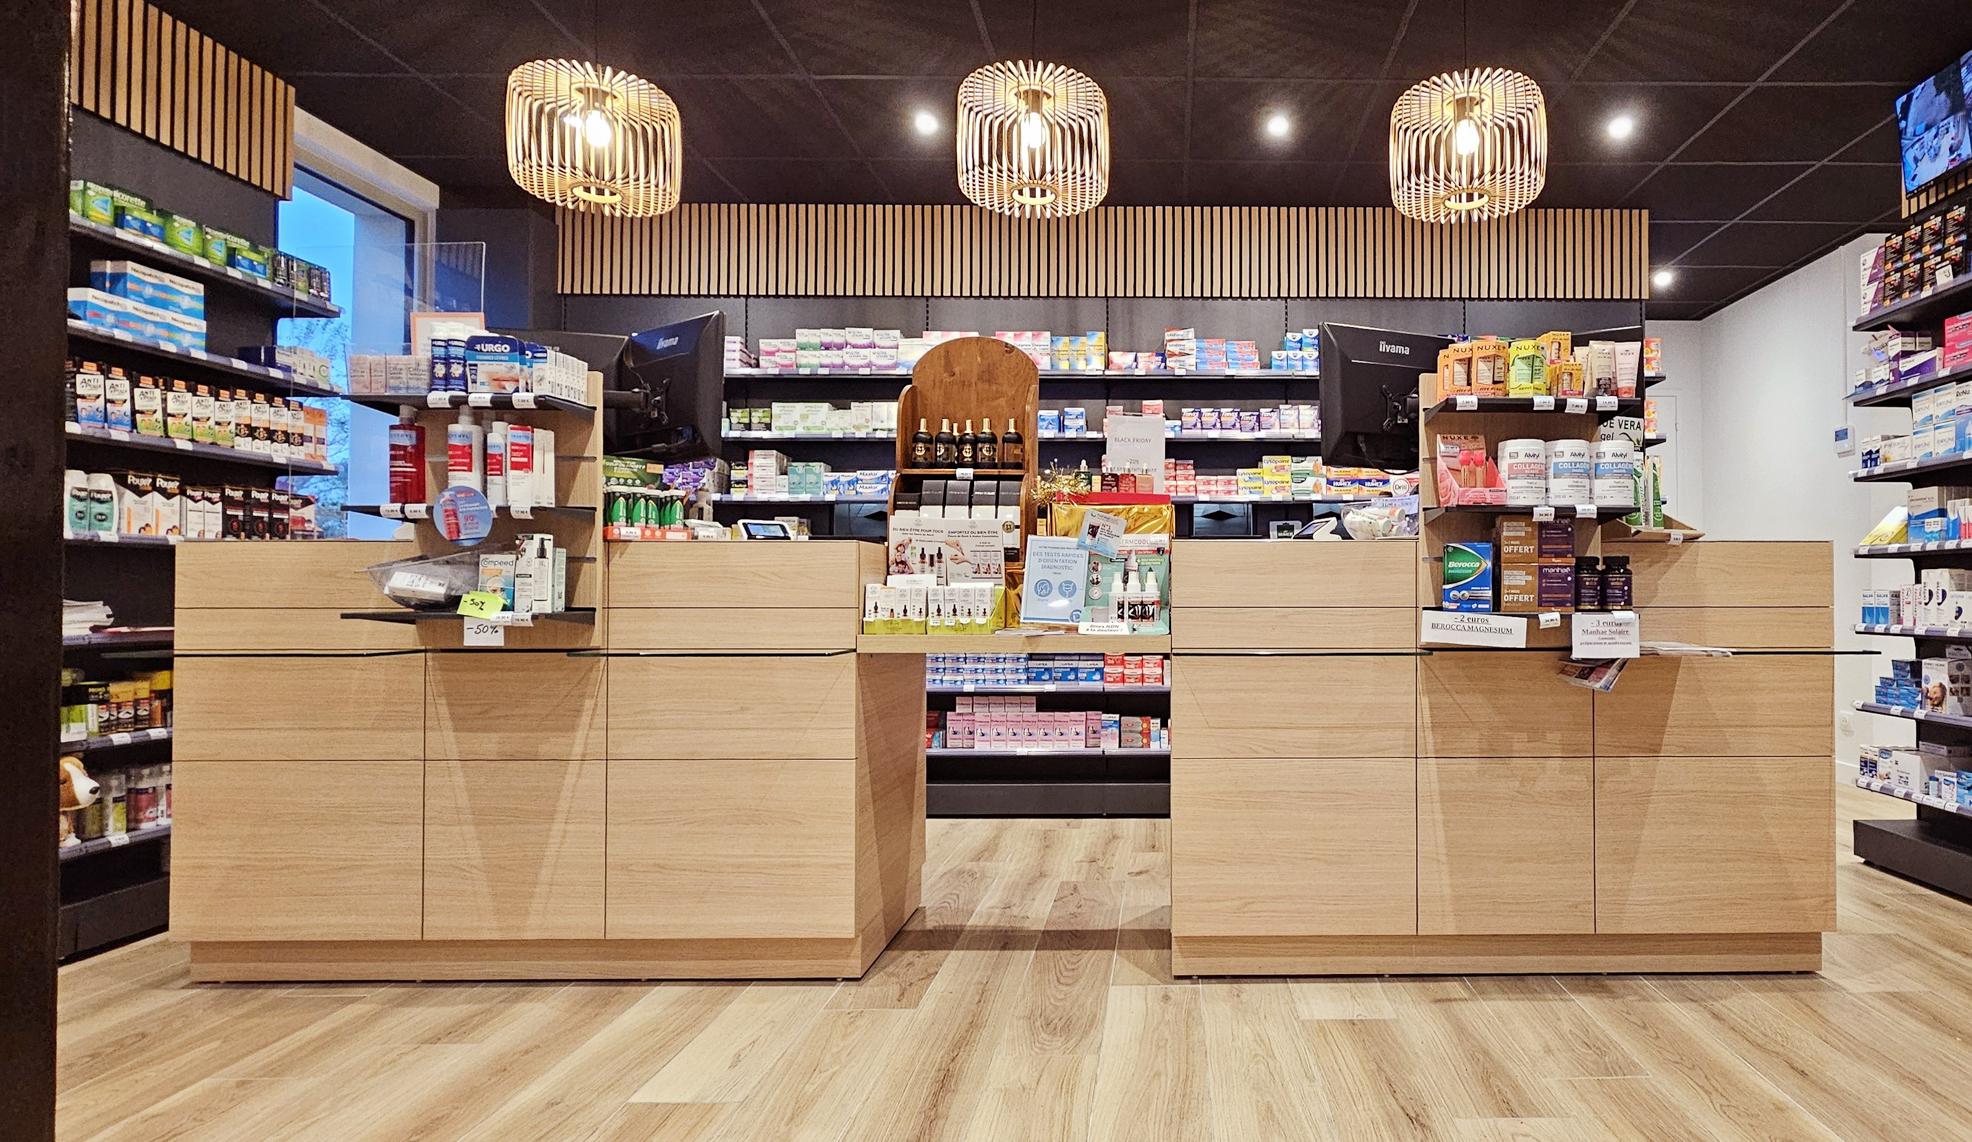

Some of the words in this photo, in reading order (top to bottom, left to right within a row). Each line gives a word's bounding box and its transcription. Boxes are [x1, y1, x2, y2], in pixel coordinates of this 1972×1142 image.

[481, 344, 510, 352] URGO
[1379, 340, 1410, 355] iiyama
[80, 377, 99, 385] ANTI
[1618, 420, 1642, 431] VERA
[1600, 432, 1614, 441] gel
[480, 557, 514, 567] Compeed
[1504, 594, 1535, 602] OFFERT
[466, 624, 499, 635] -50%
[1431, 623, 1466, 631] BEROCCA
[1467, 625, 1513, 634] MAGNESIUM
